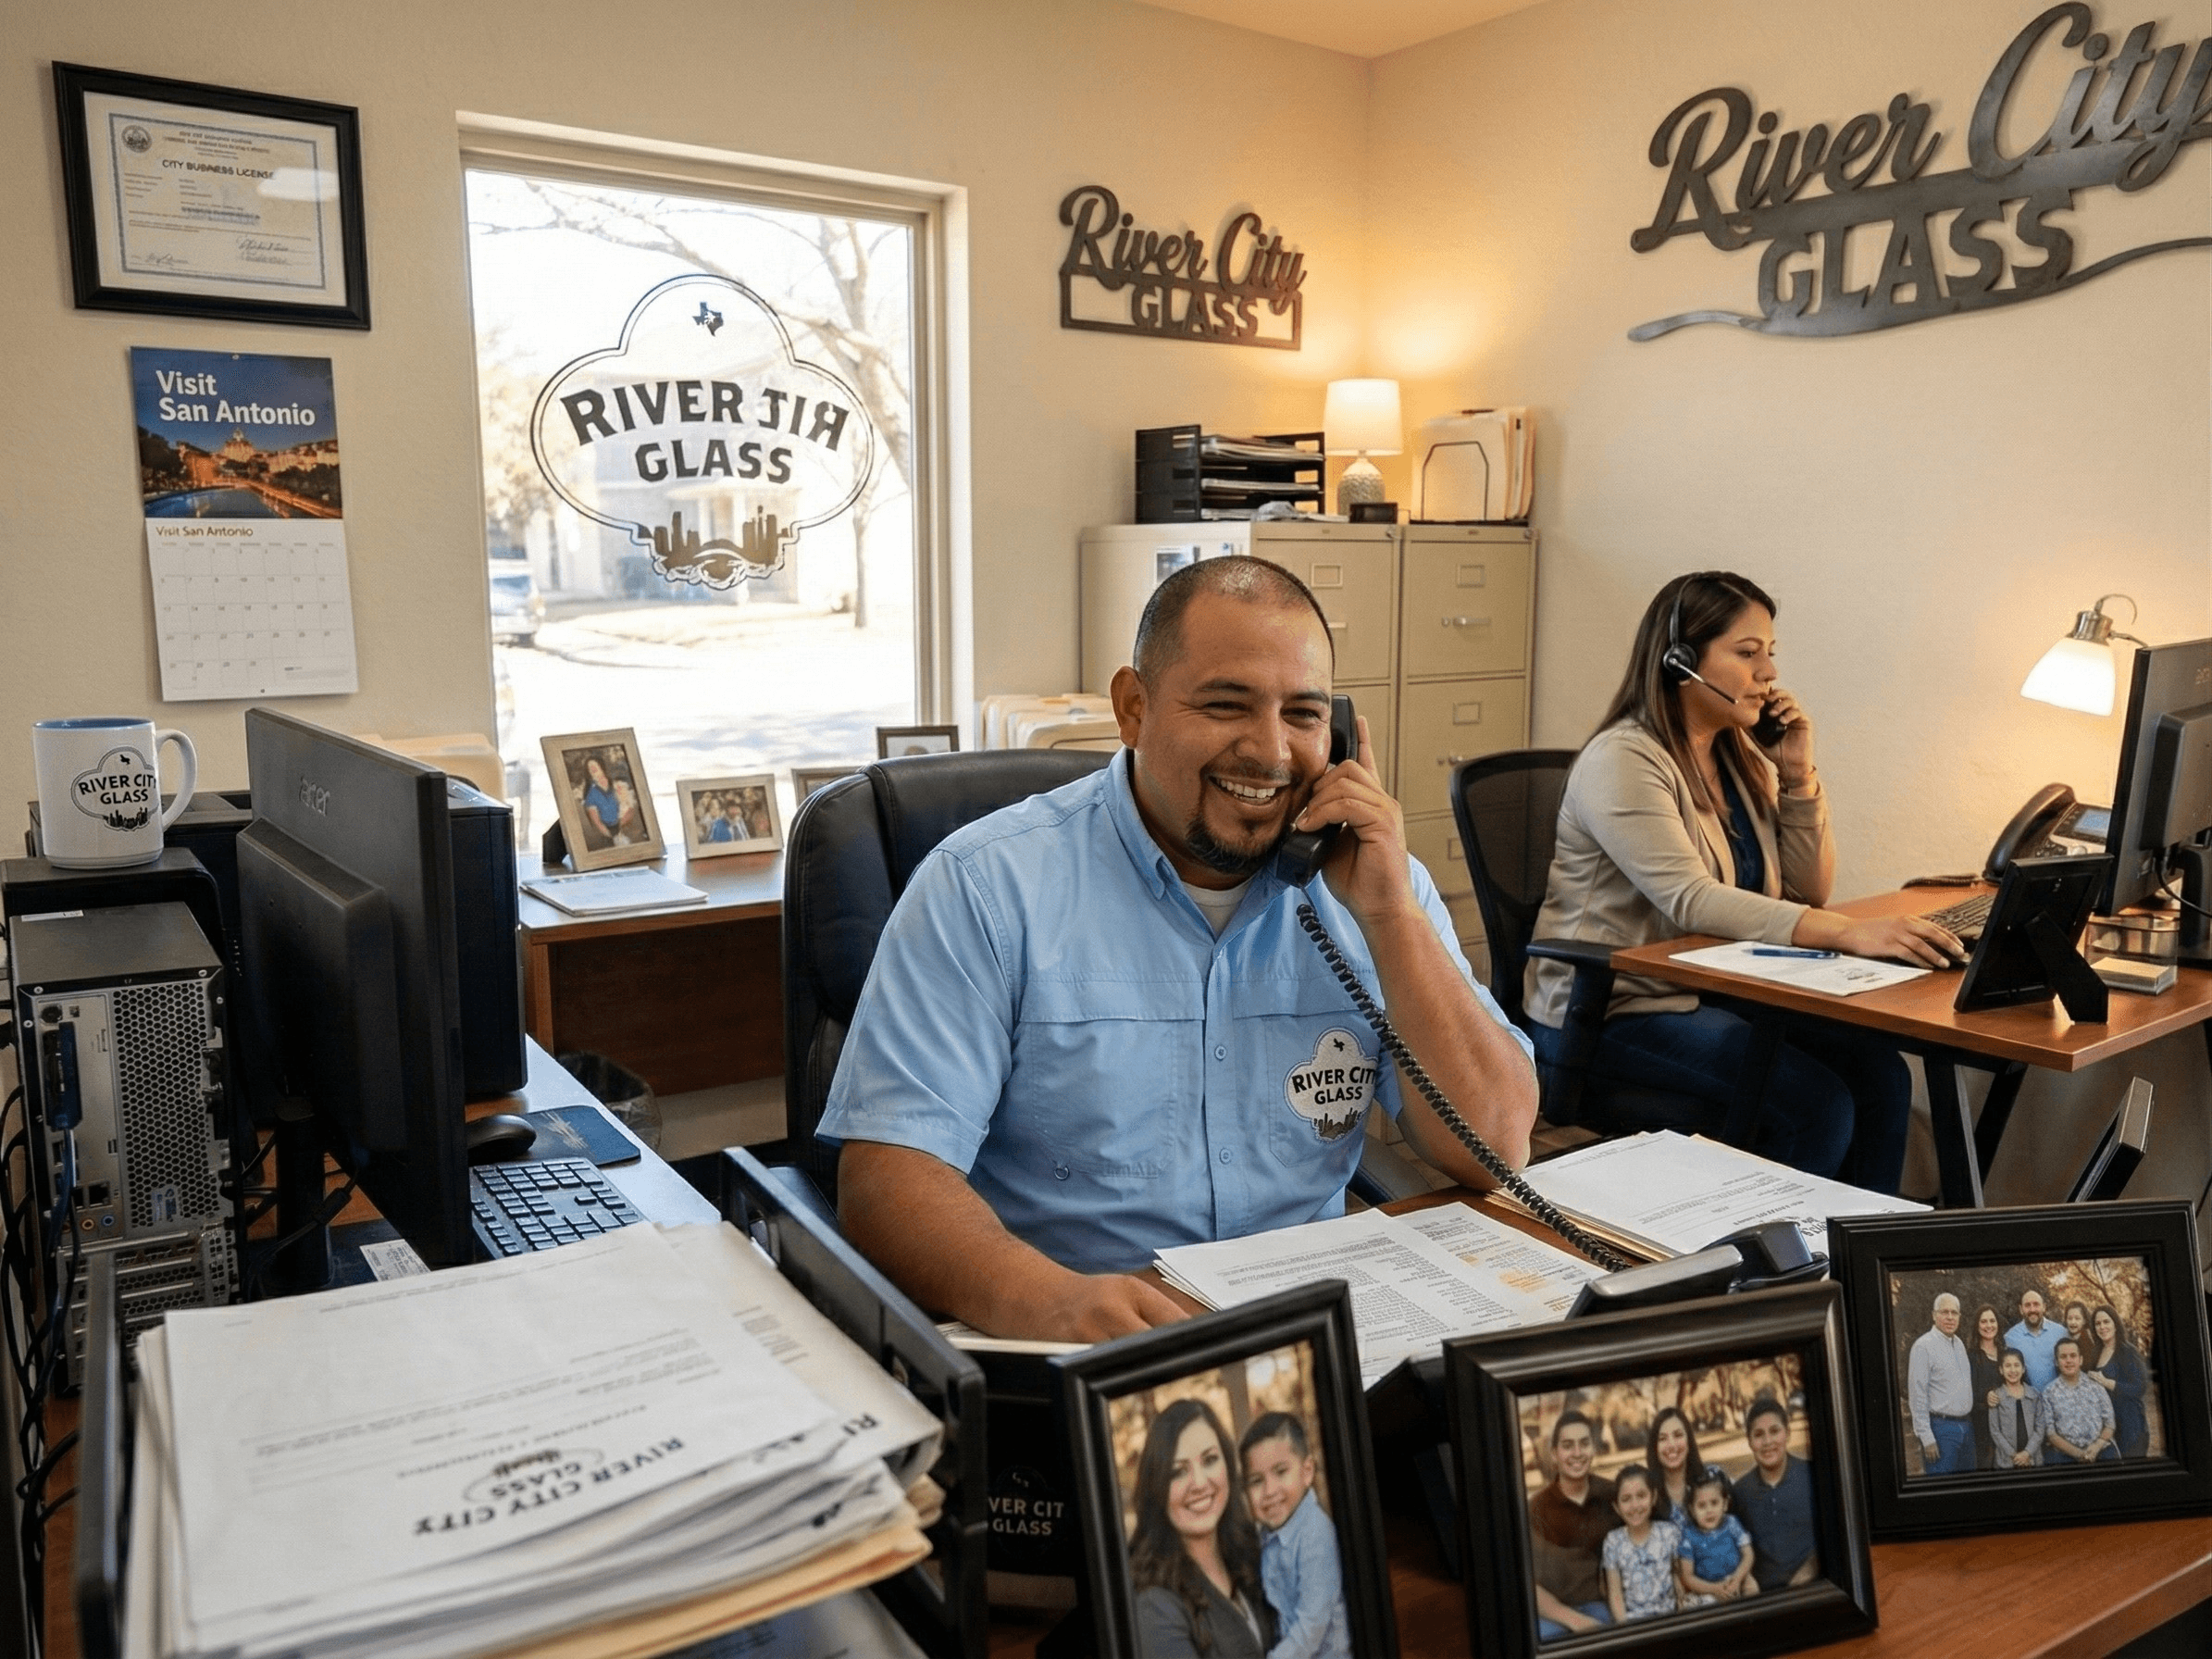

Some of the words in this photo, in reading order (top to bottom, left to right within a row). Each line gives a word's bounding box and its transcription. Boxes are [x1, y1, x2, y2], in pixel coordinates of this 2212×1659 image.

[1631, 87, 1941, 251] River
[1969, 2, 2212, 192] City
[162, 159, 184, 168] CITY
[1059, 185, 1209, 287] River
[1217, 212, 1307, 316] City
[1758, 185, 2075, 319] GLASS
[1131, 282, 1259, 338] GLASS
[155, 370, 217, 396] Visit
[159, 397, 209, 422] San
[215, 400, 316, 426] Antonio
[559, 380, 744, 446] RIVER
[634, 440, 794, 484] GLASS
[182, 526, 204, 537] San
[206, 526, 254, 537] Antonio
[78, 775, 130, 795] RIVER
[100, 789, 148, 805] GLASS
[1292, 1068, 1345, 1093] RIVER
[1314, 1086, 1362, 1104] GLASS
[591, 1437, 684, 1483] RIVER
[490, 1462, 582, 1497] GLASS
[508, 1481, 581, 1516] CITY
[992, 1518, 1052, 1536] GLASS
